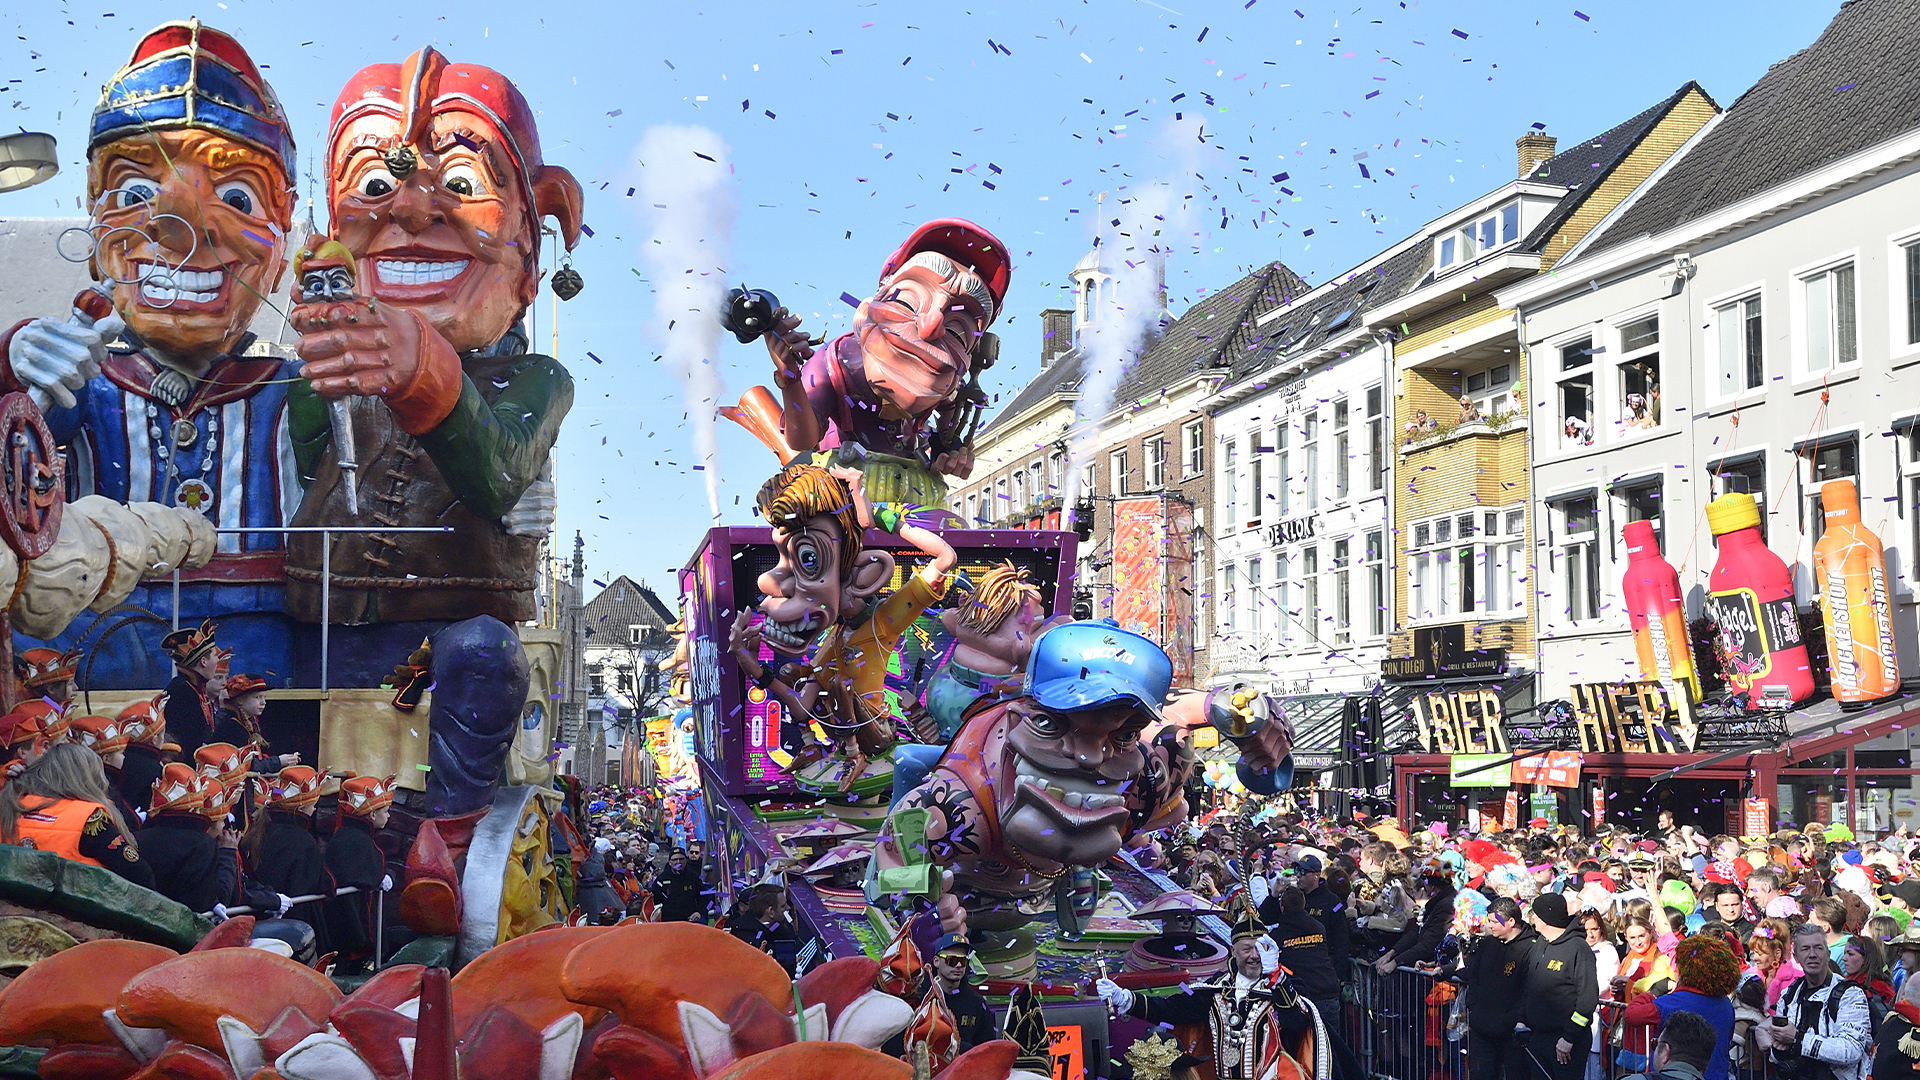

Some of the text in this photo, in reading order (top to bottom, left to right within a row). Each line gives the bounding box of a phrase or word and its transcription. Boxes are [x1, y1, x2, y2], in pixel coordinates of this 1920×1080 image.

[1268, 516, 1314, 546] DE KLOK
[1827, 572, 1857, 688] ROCKETSHOT
[1382, 659, 1425, 676] CON FUEGO
[1466, 660, 1498, 669] RESTAURANT
[1363, 675, 1380, 690] Dine
[1428, 682, 1681, 754] BIER HIER
